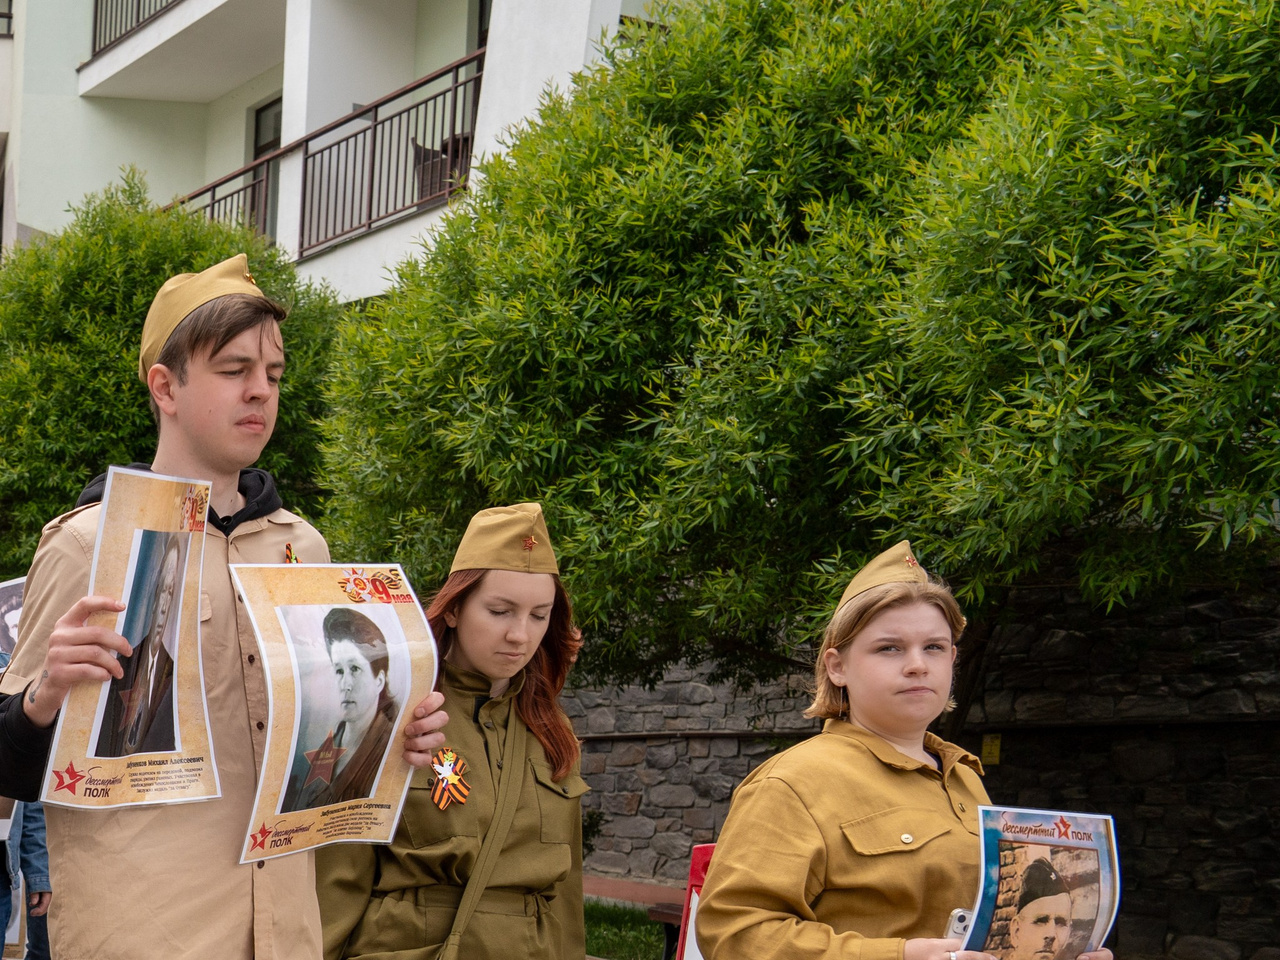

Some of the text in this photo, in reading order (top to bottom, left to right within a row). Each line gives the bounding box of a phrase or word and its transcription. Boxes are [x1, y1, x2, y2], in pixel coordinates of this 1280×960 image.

[370, 577, 414, 604] 9 мая
[83, 787, 111, 798] ПОЛК
[269, 835, 294, 849] ПОЛК
[1071, 830, 1094, 842] ПОЛК
